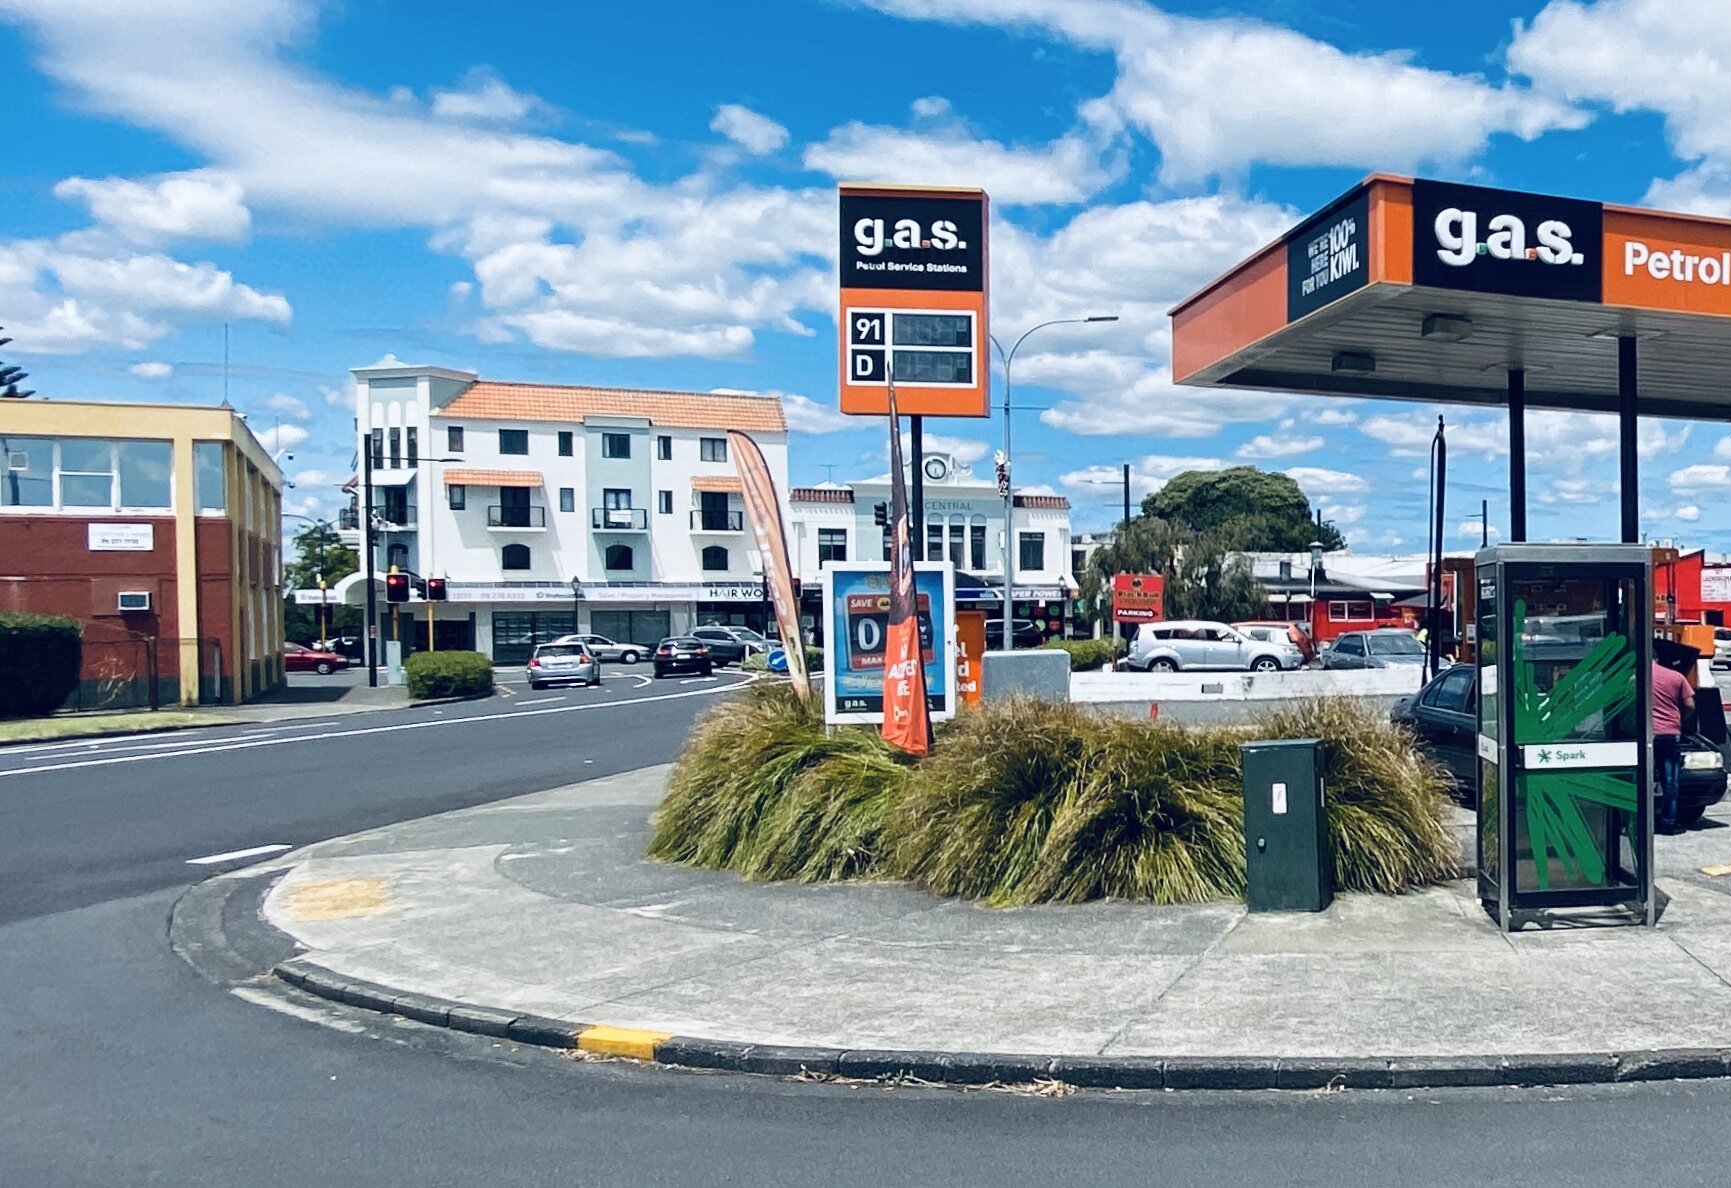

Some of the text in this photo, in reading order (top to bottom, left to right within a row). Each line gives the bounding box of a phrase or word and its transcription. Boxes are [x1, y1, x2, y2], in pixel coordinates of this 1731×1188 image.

[856, 261, 968, 274] Petrol Service Stations
[1624, 241, 1731, 285] Petrol
[855, 318, 880, 341] 91
[856, 354, 874, 376] D
[924, 501, 973, 511] CENTRAL
[709, 588, 738, 598] HAIR
[850, 598, 873, 608] SAVE
[1117, 609, 1154, 617] PARKING
[1556, 750, 1586, 761] Spark
